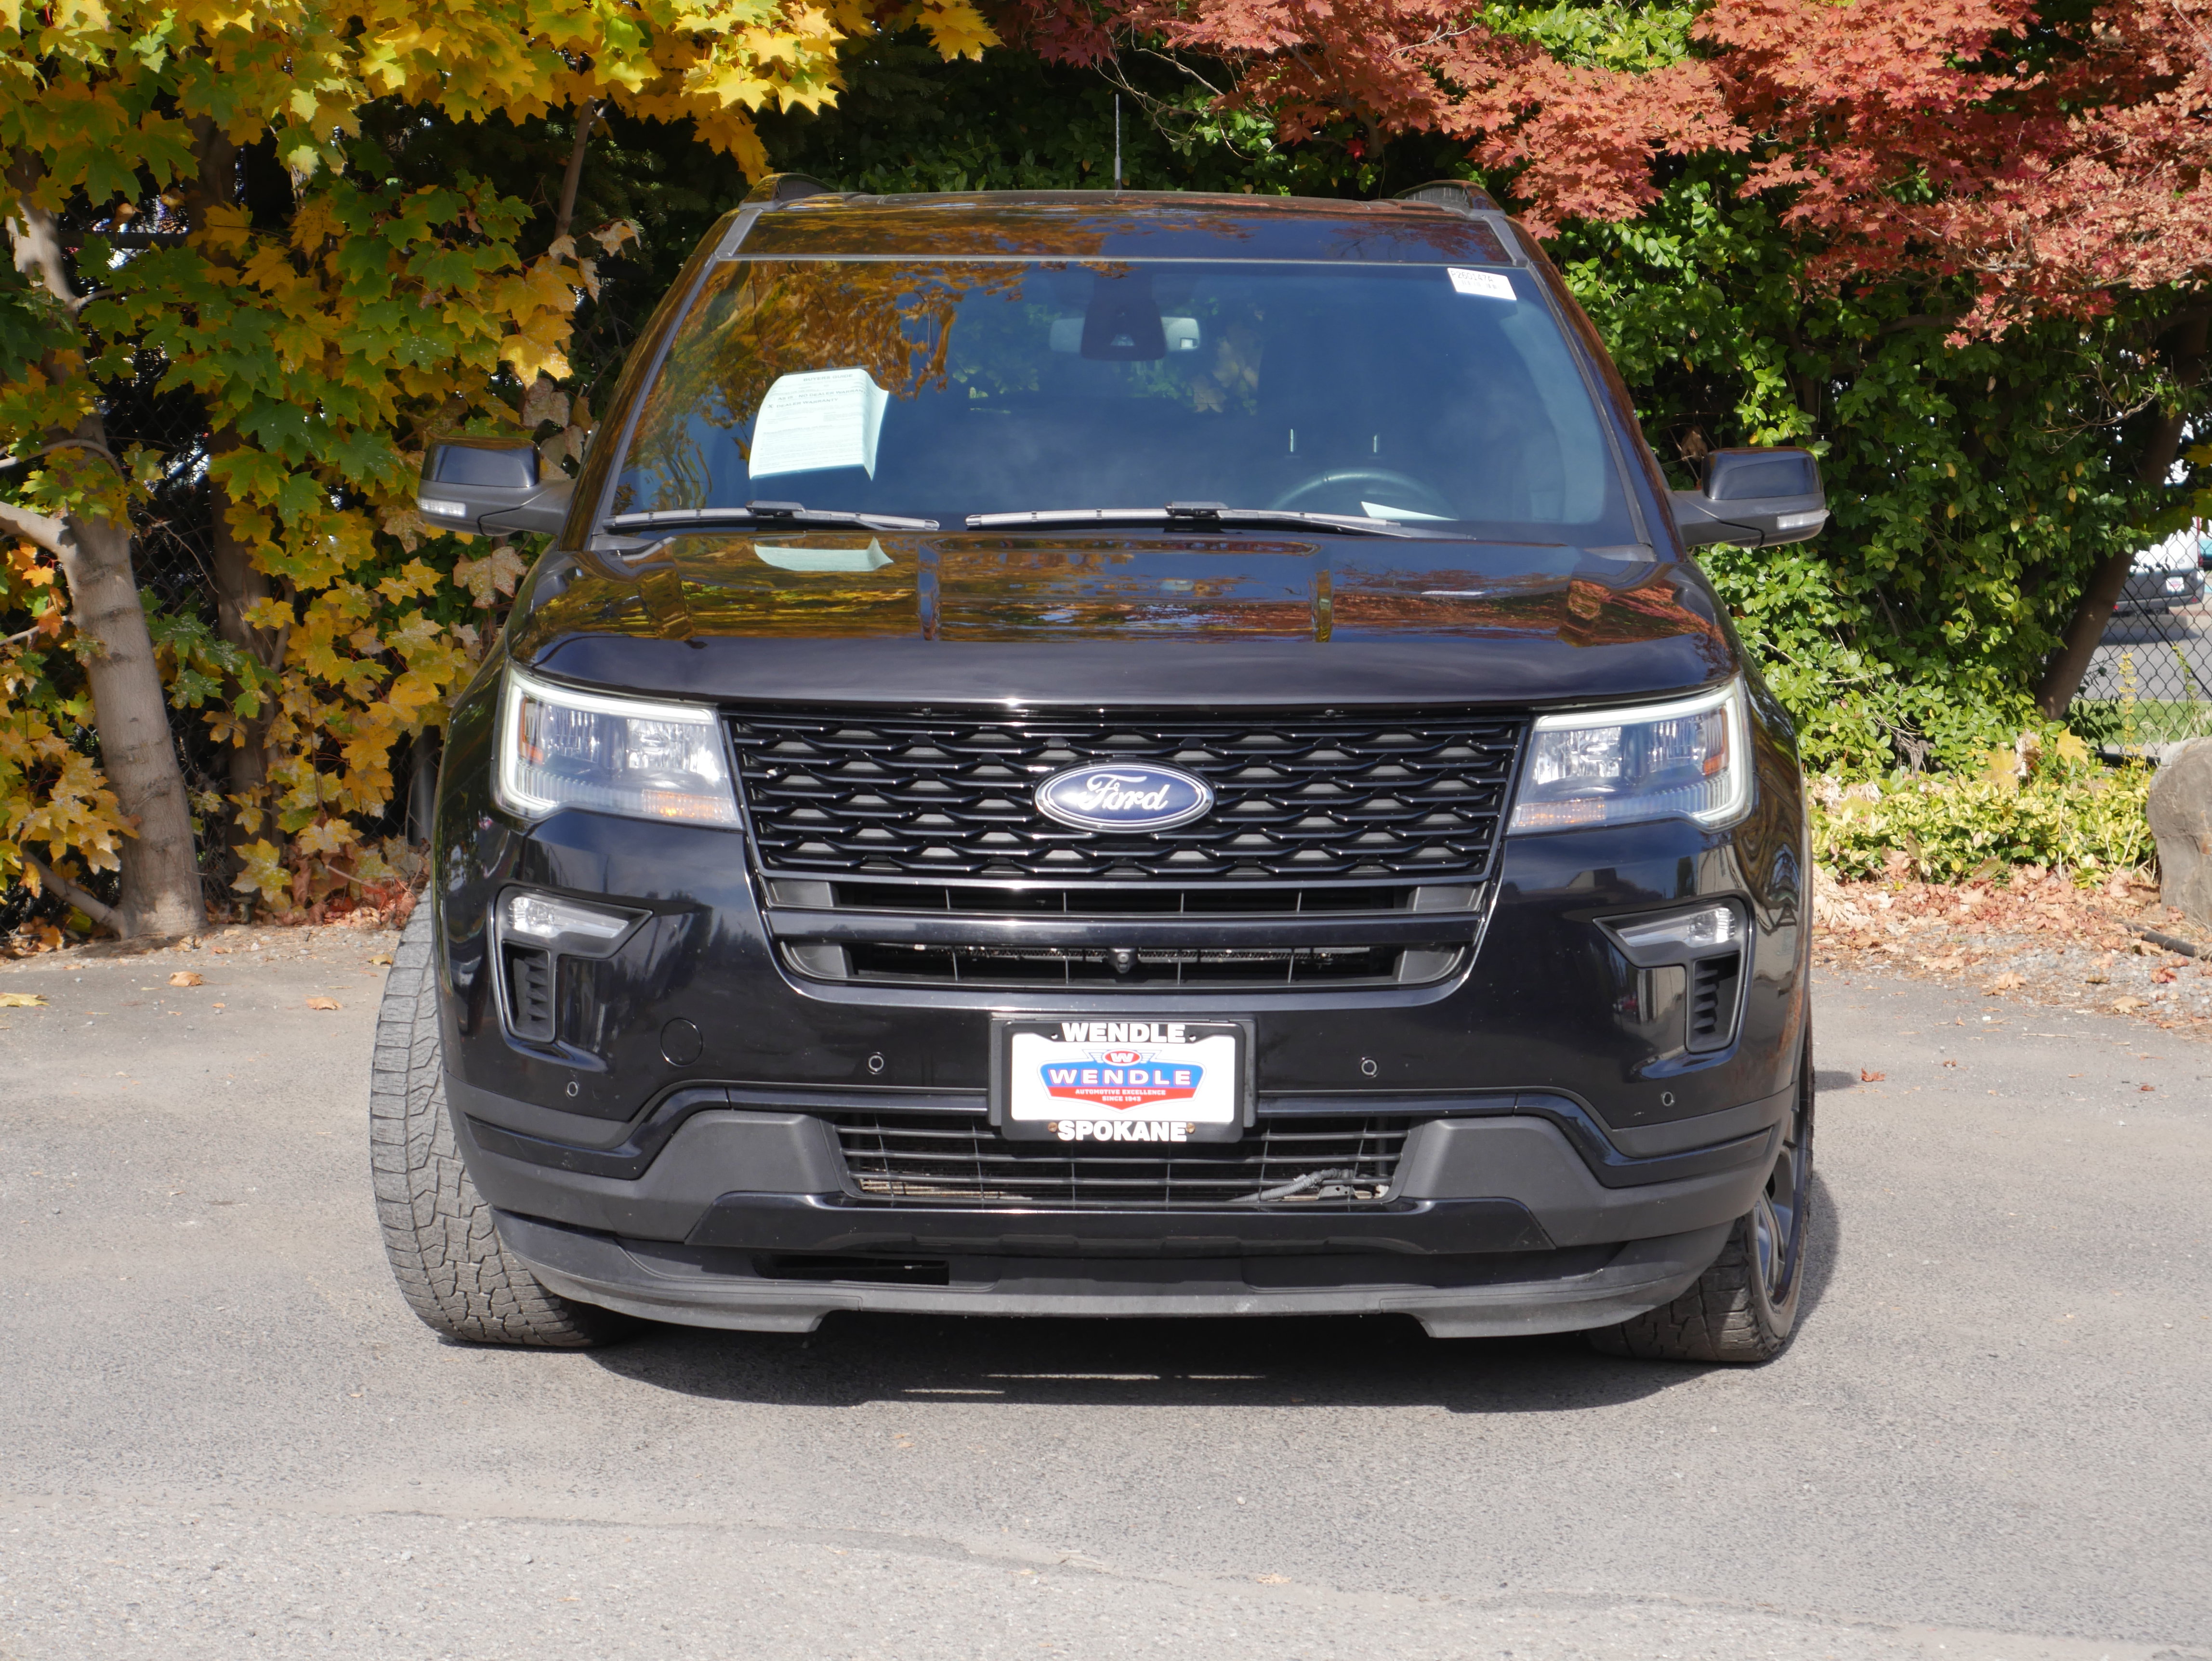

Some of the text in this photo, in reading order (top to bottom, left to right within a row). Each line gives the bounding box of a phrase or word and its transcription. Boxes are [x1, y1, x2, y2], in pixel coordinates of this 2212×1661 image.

[1062, 774, 1170, 810] Ford
[1061, 1022, 1186, 1043] WENDLE
[1110, 1053, 1134, 1063] W
[1049, 1069, 1191, 1085] WENDLE
[1057, 1120, 1187, 1141] SPOKANE
